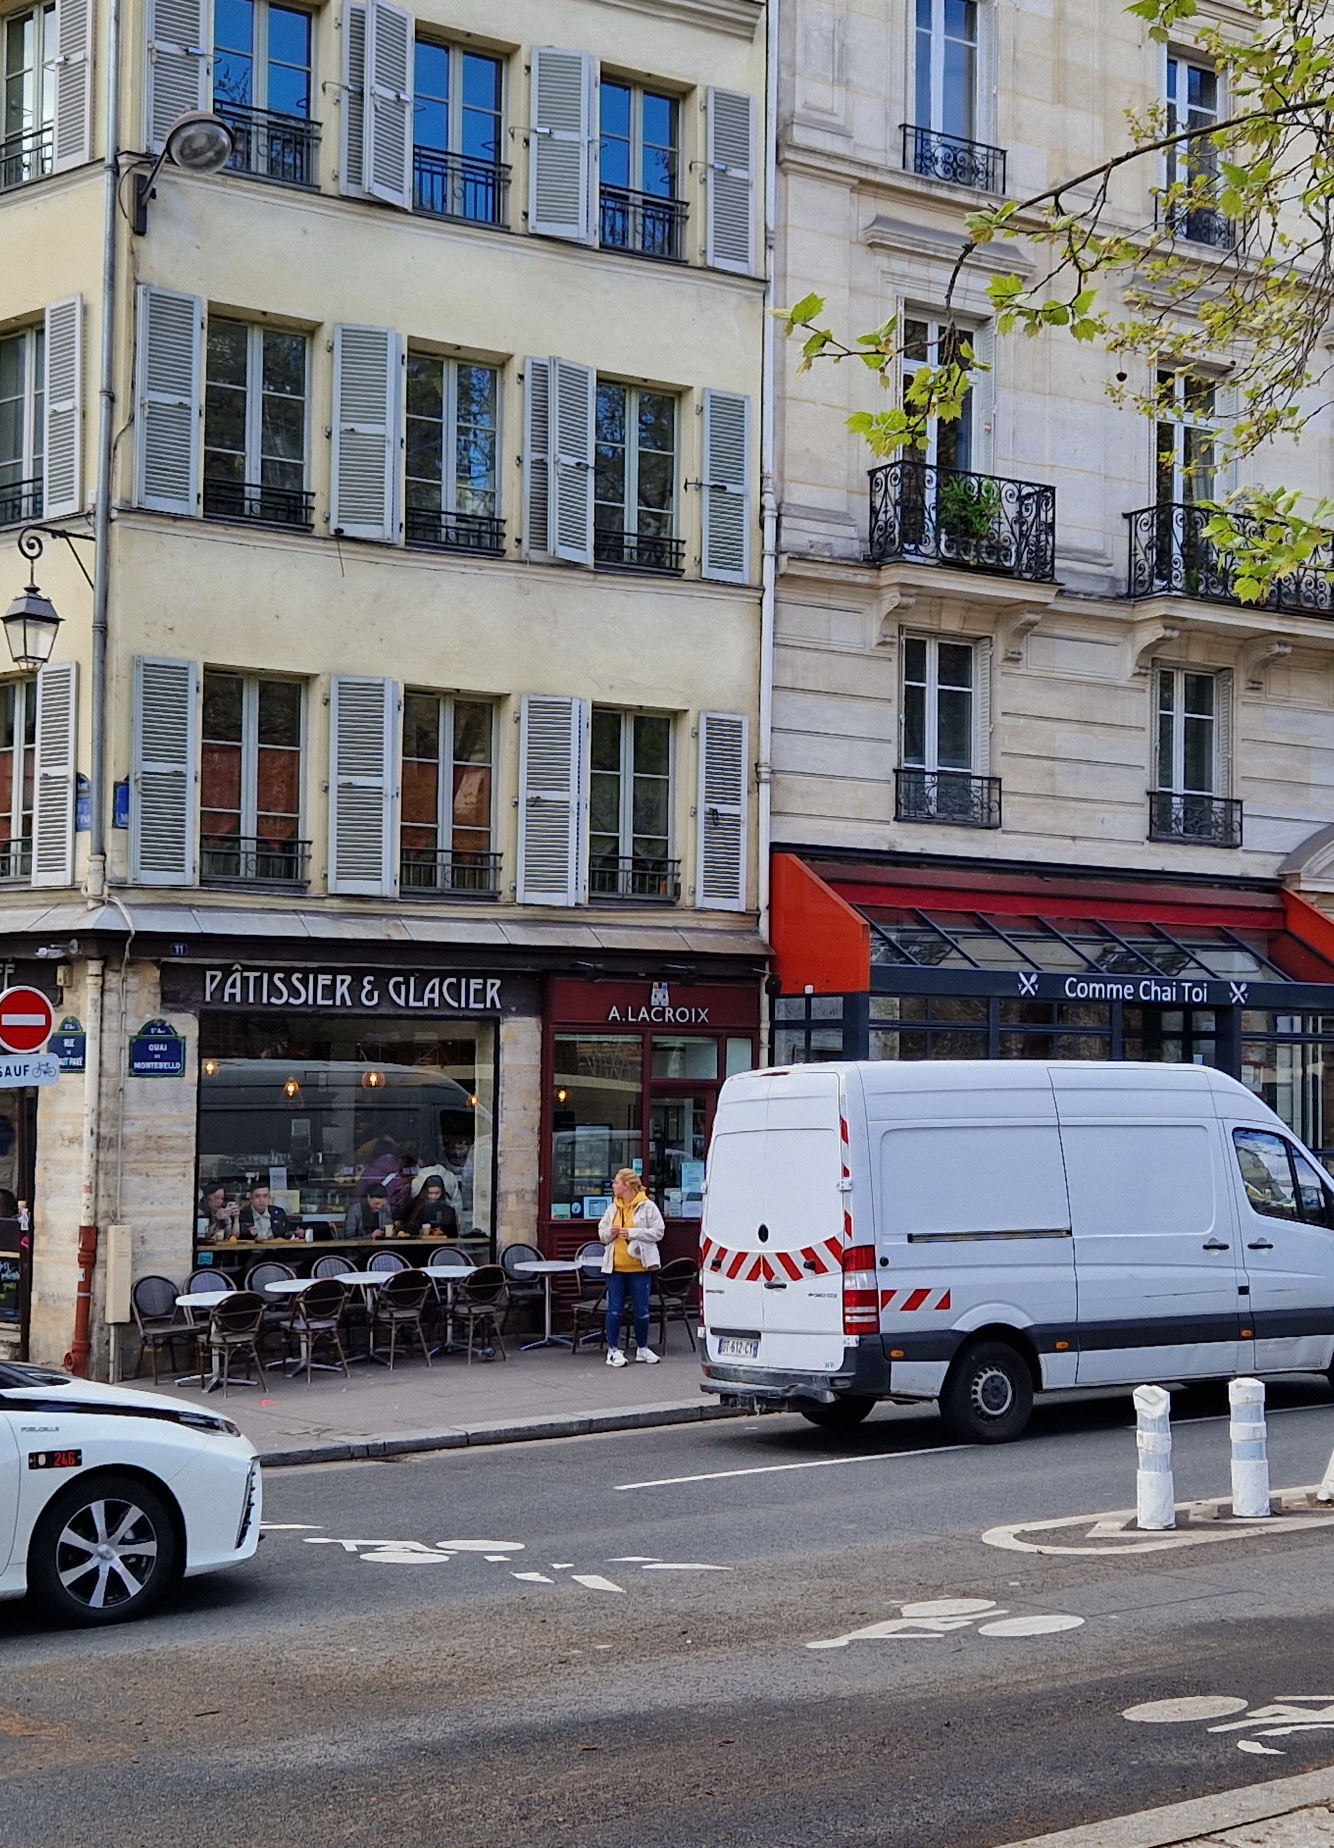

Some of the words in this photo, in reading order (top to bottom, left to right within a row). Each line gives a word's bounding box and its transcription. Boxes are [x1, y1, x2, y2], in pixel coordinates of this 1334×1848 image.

[174, 945, 184, 955] 11
[204, 963, 353, 1007] PÂTISSIER
[361, 975, 379, 1007] &
[387, 975, 503, 1009] GLACIER
[1064, 976, 1135, 1000] Comme
[1138, 979, 1177, 1002] Chai
[1180, 982, 1209, 1003] Toi
[148, 1043, 167, 1051] QUAI
[133, 1061, 181, 1070] MONTEBELLO
